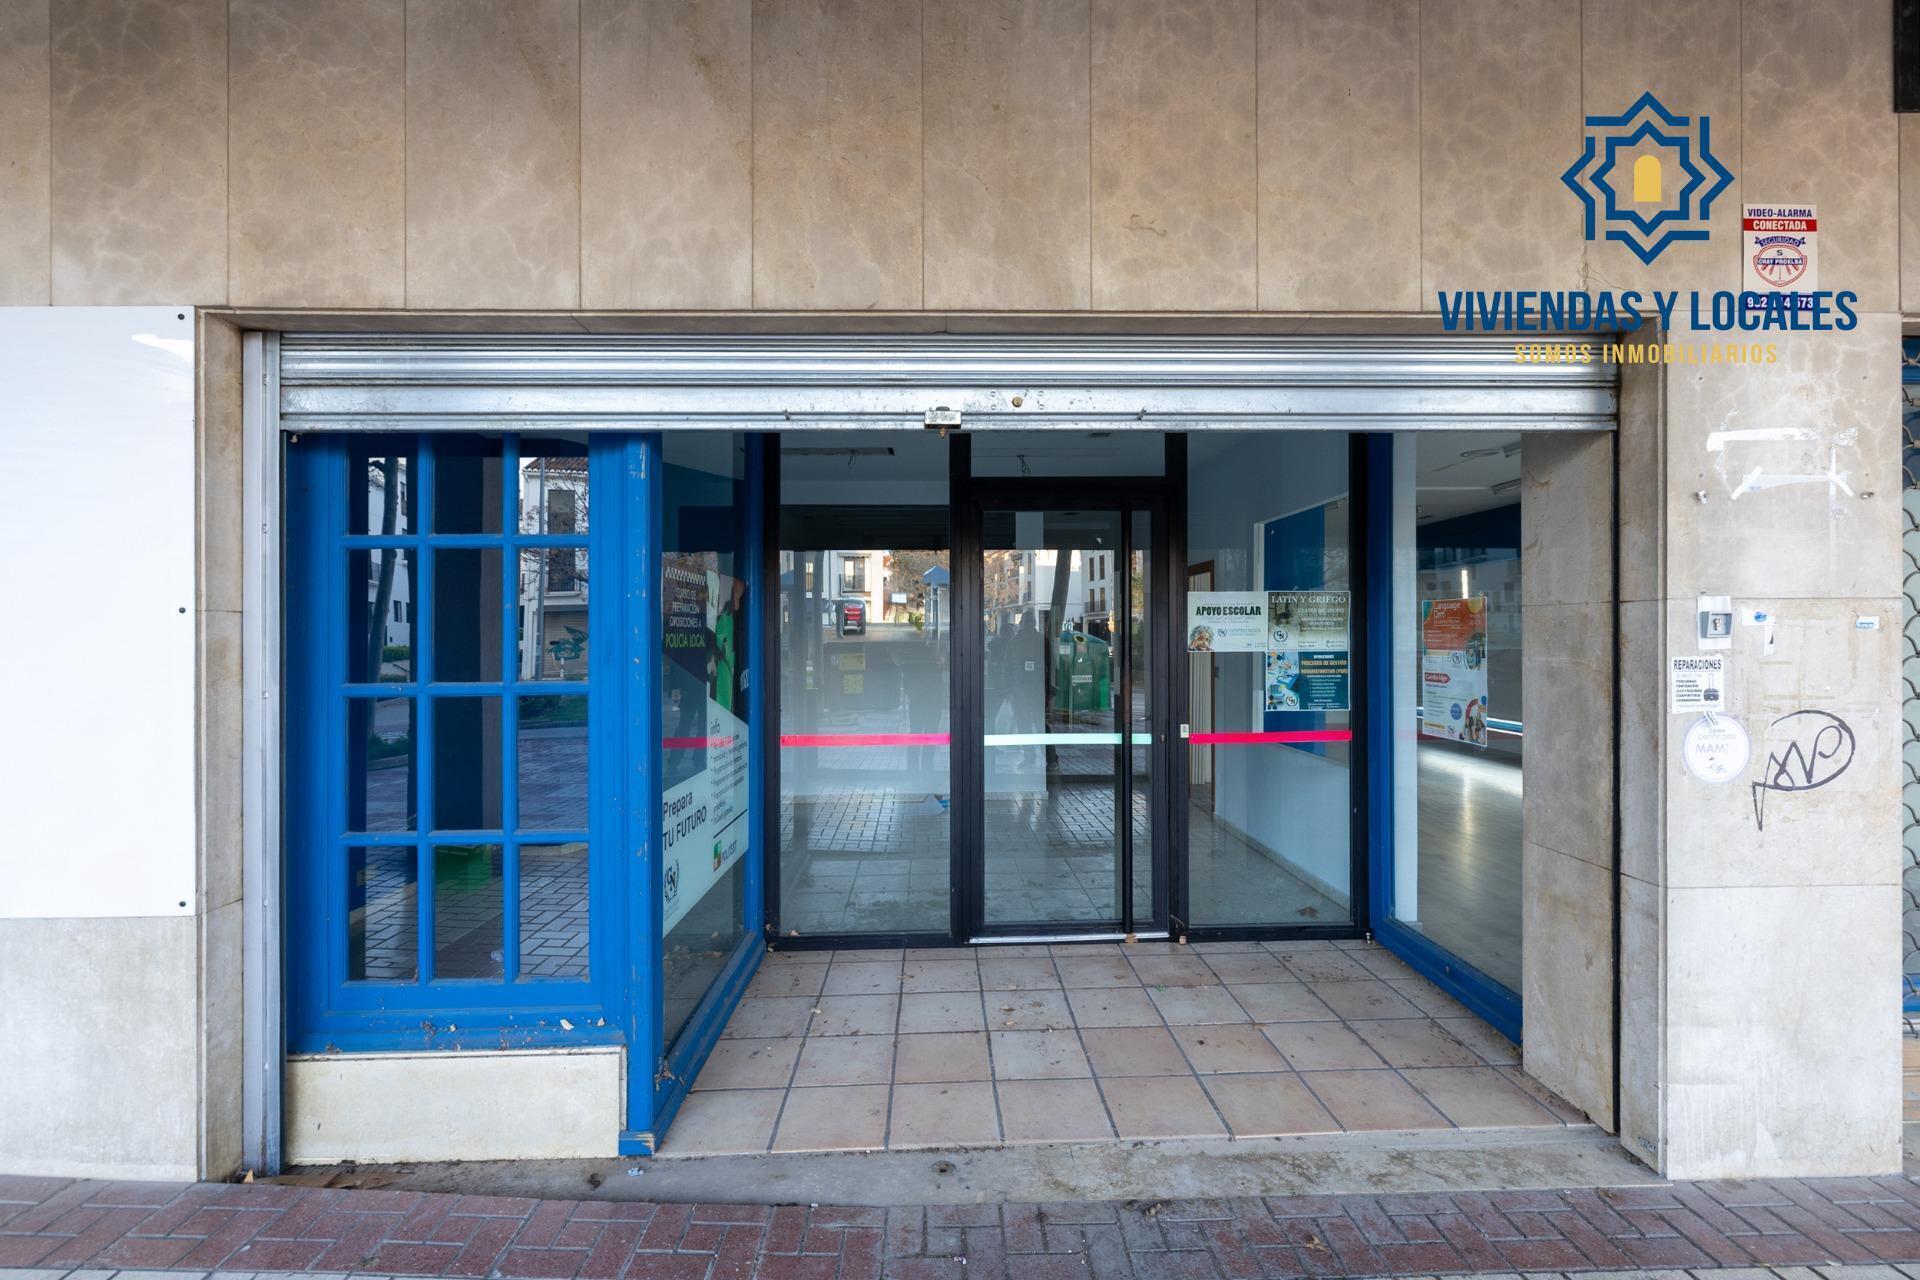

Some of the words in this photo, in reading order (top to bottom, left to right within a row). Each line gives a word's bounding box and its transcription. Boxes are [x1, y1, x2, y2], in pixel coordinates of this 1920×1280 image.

[1747, 208, 1812, 218] VIDEO-ALARMA
[1753, 220, 1807, 231] CONECTADA
[1760, 236, 1800, 246] SEGURIDAD
[1300, 595, 1307, 604] Y
[1308, 595, 1346, 604] GRIEGO
[1195, 606, 1222, 616] APOYO
[1223, 606, 1262, 616] ESCOLAR
[1673, 659, 1721, 670] REPARACIONES
[663, 791, 693, 821] Prepara
[663, 827, 674, 851] TU
[677, 805, 707, 842] FUTURO
